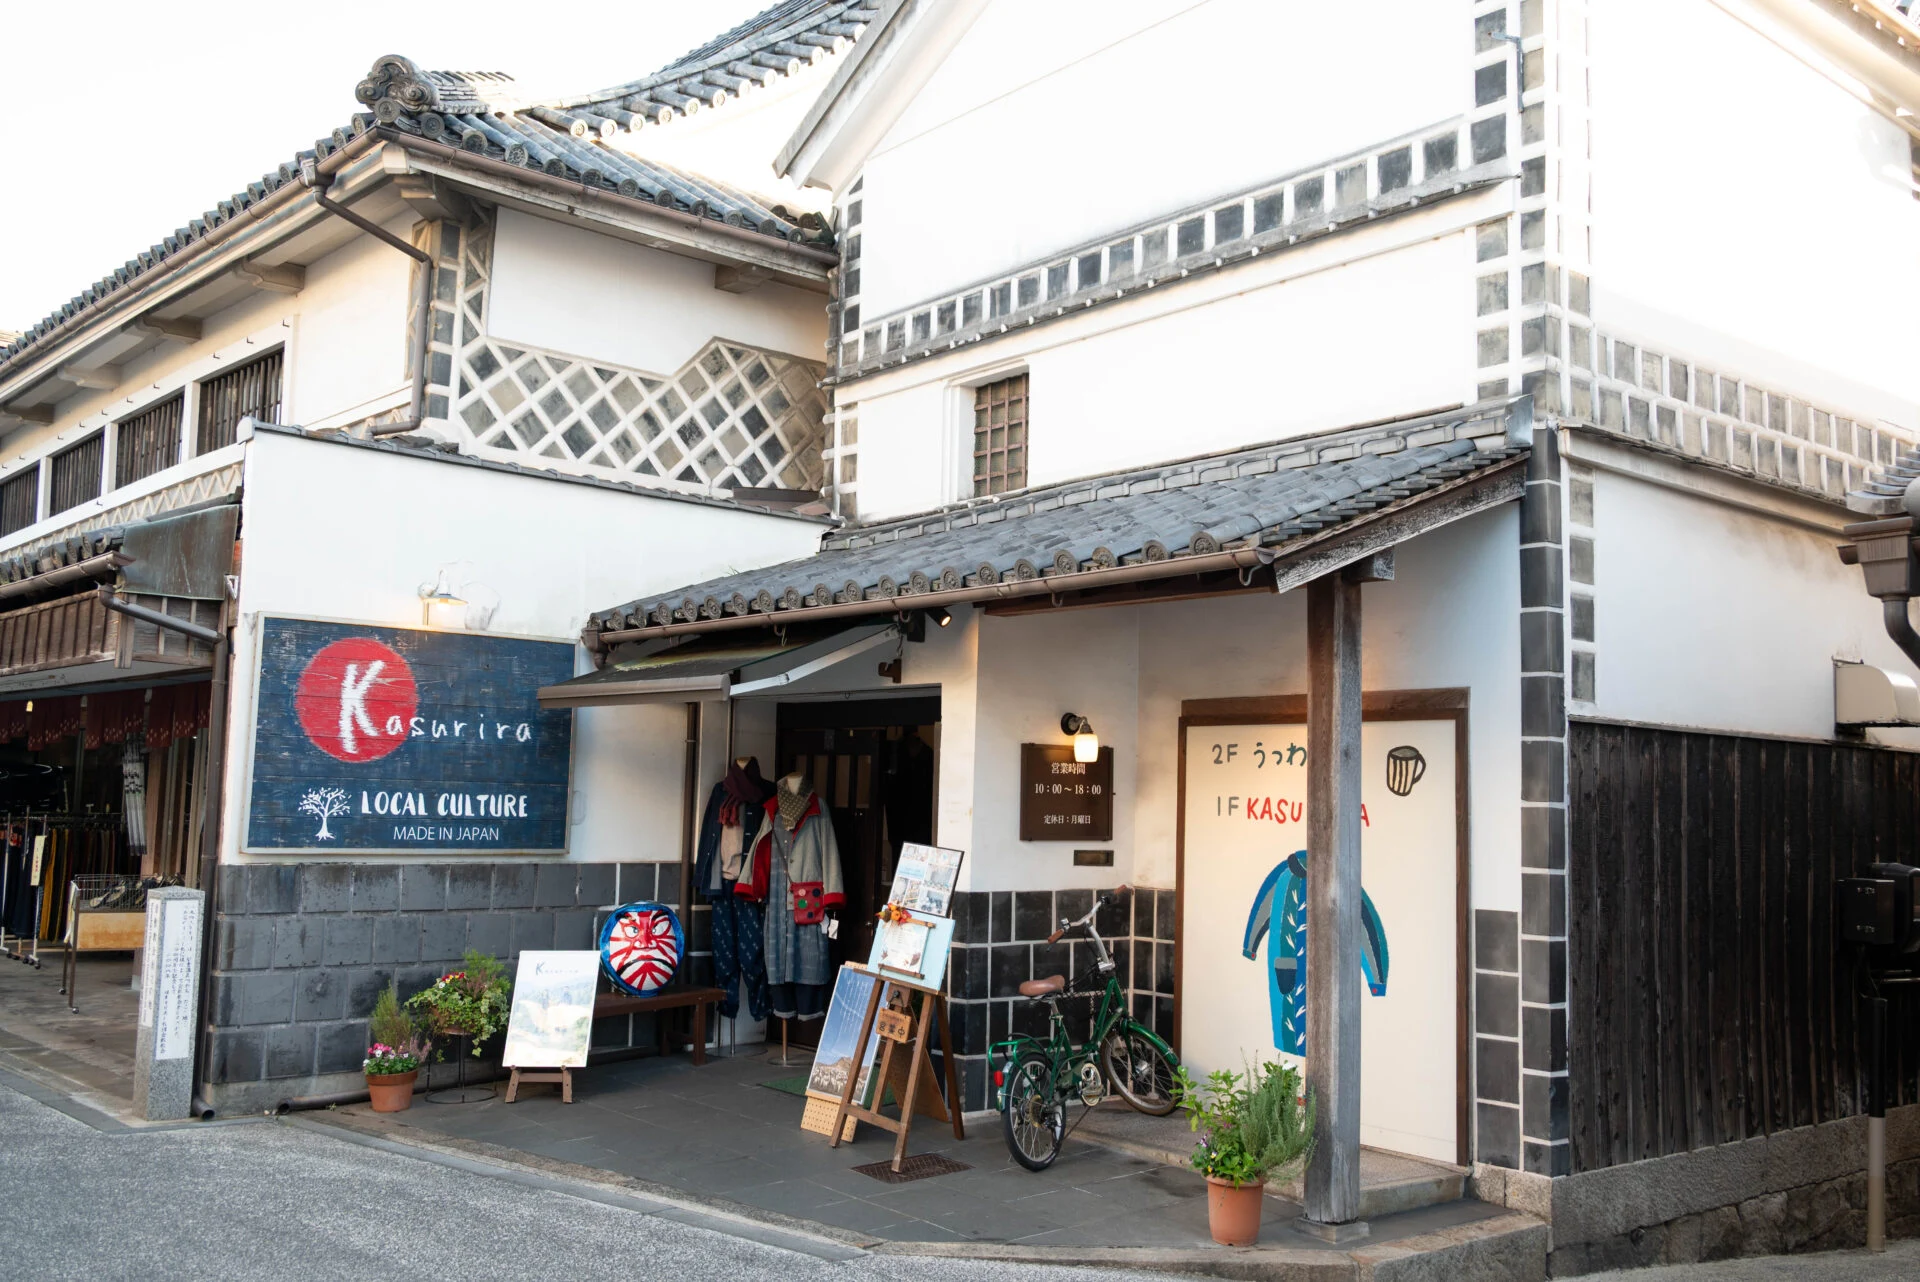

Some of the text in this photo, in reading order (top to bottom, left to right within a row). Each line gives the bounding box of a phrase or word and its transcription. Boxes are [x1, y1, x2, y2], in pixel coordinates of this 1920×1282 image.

[339, 660, 531, 754] Kasurira
[1212, 743, 1239, 765] 2F
[1051, 762, 1086, 775] 営業時間
[361, 790, 528, 818] LOCAL CULTURE
[1217, 796, 1240, 816] 1F
[393, 826, 499, 841] MADE IN JAPAN
